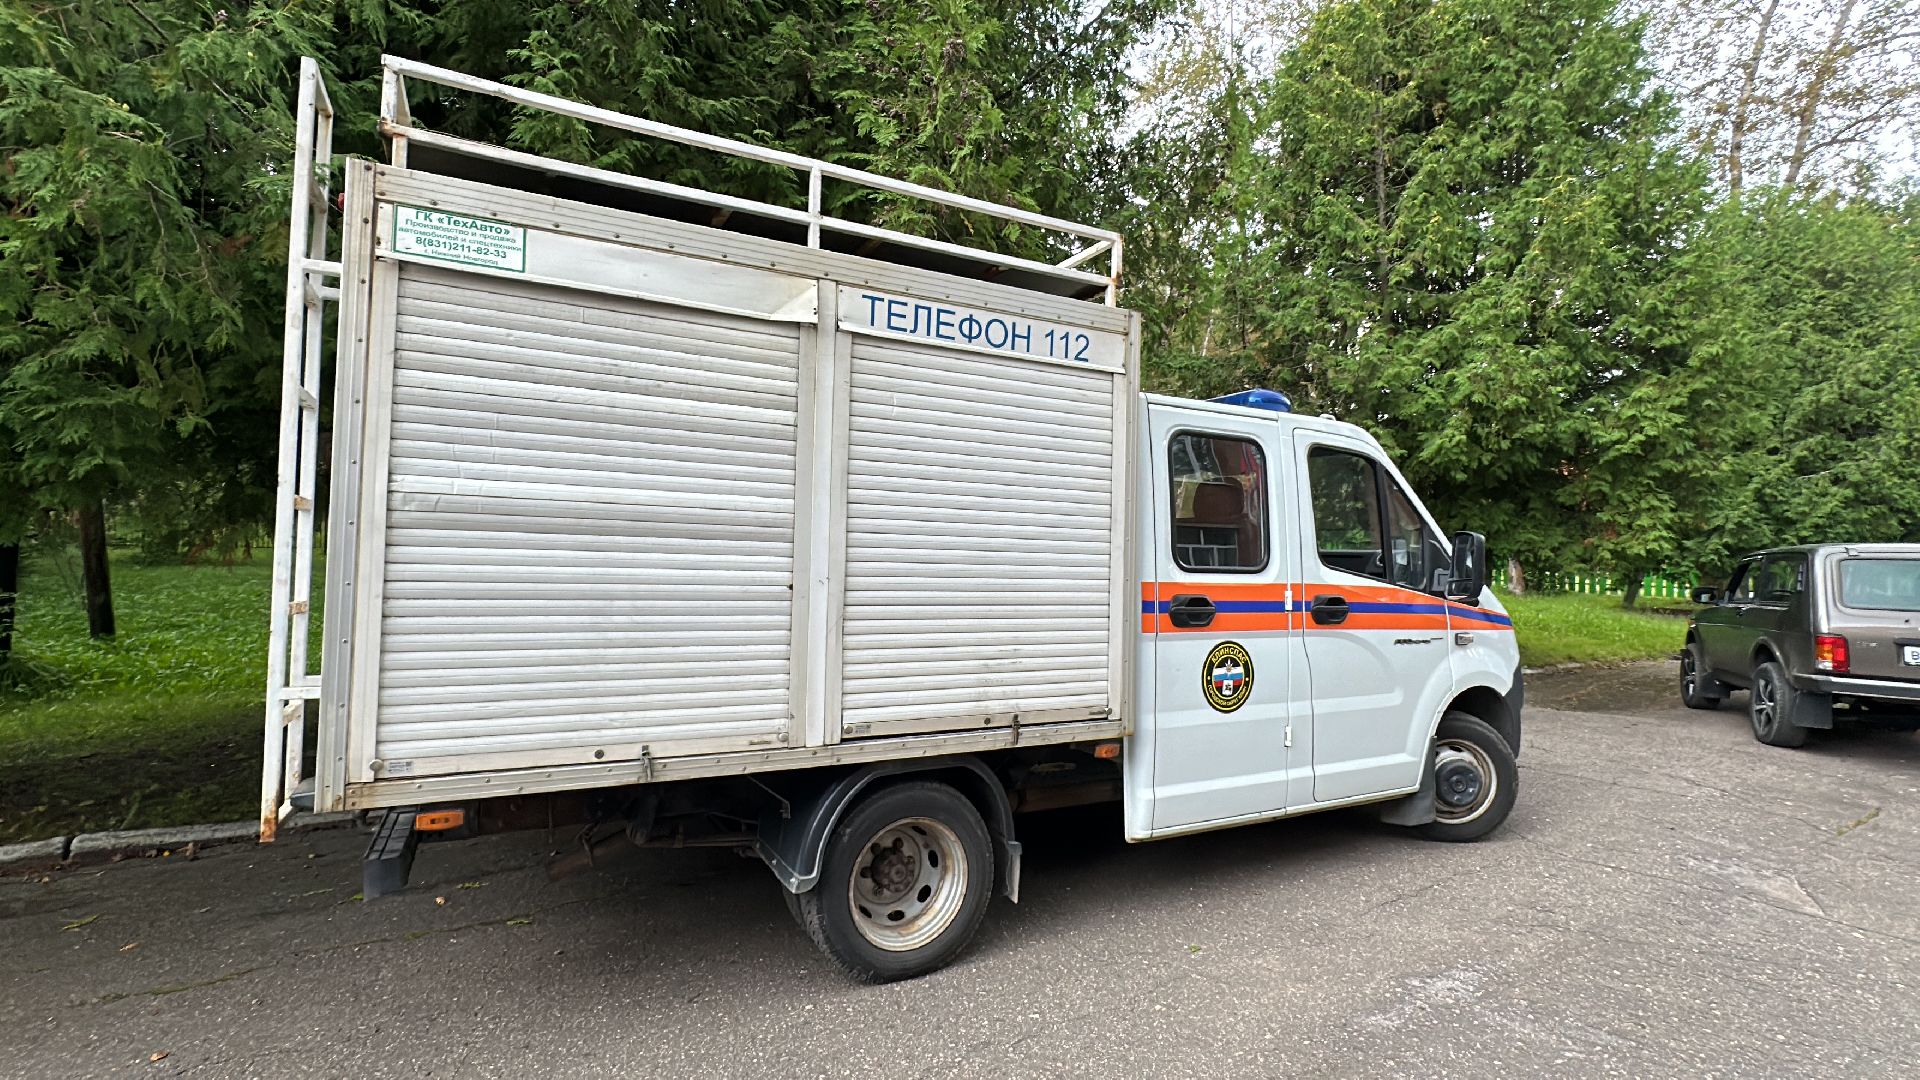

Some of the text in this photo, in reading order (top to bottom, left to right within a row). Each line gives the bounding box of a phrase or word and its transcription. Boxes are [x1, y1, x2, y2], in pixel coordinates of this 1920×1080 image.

[415, 210, 433, 222] ГК
[398, 226, 459, 242] автомобилей
[469, 239, 522, 252] спецтехники
[405, 218, 469, 236] Производство
[480, 232, 517, 244] продажа
[415, 236, 507, 259] 8(831)211-82-33
[861, 294, 1090, 362] ТЕЛЕФОН 112
[1211, 647, 1247, 664] КЛИНСПАС
